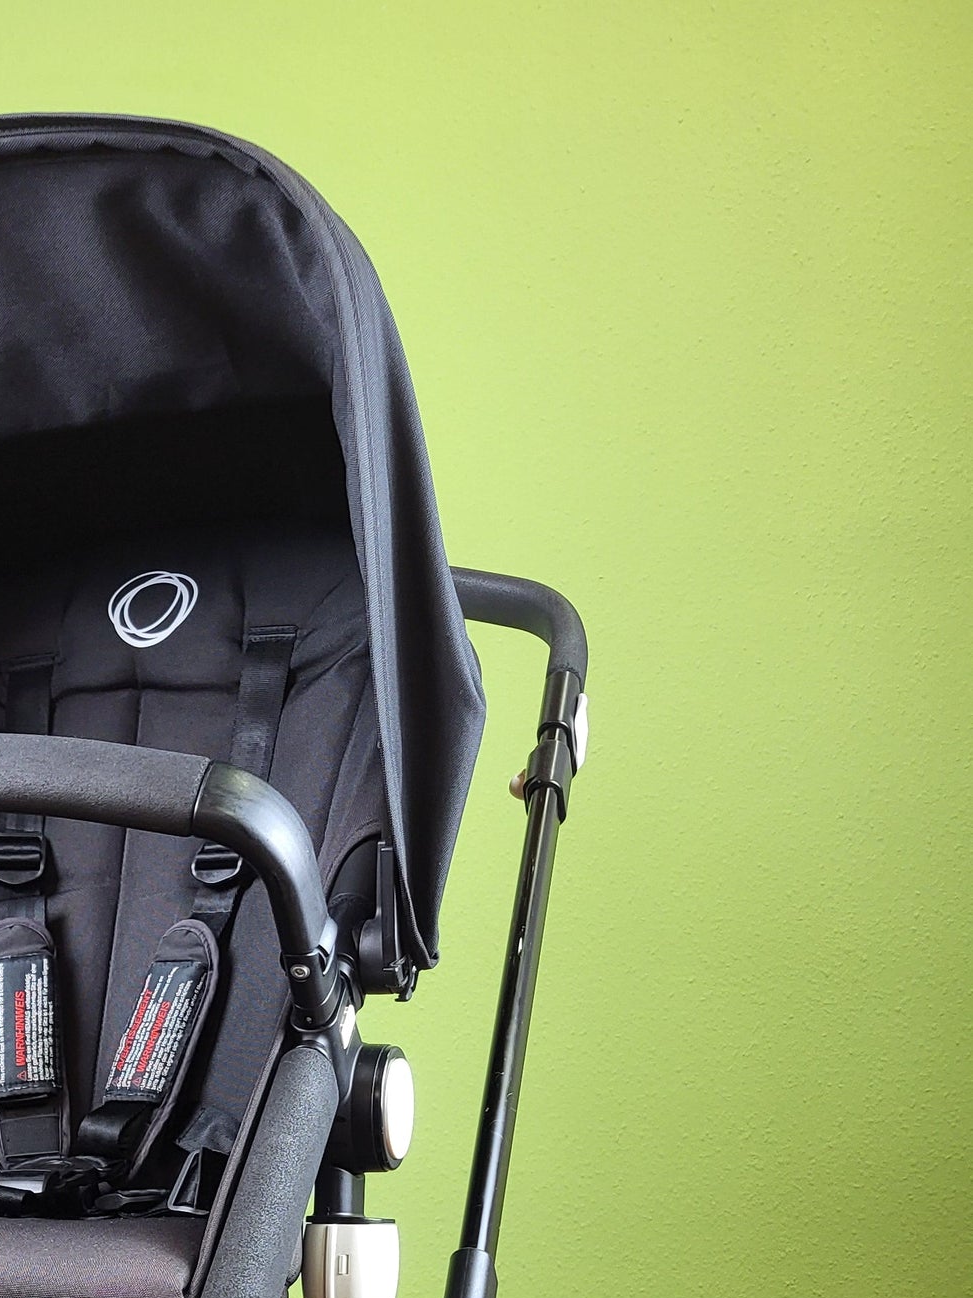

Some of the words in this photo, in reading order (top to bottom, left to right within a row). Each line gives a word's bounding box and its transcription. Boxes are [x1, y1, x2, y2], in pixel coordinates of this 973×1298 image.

[15, 991, 26, 1067] WARNHINWEIS
[117, 989, 152, 1071] AVERTISSEMENT
[137, 1001, 171, 1072] WARNHINWEIS
